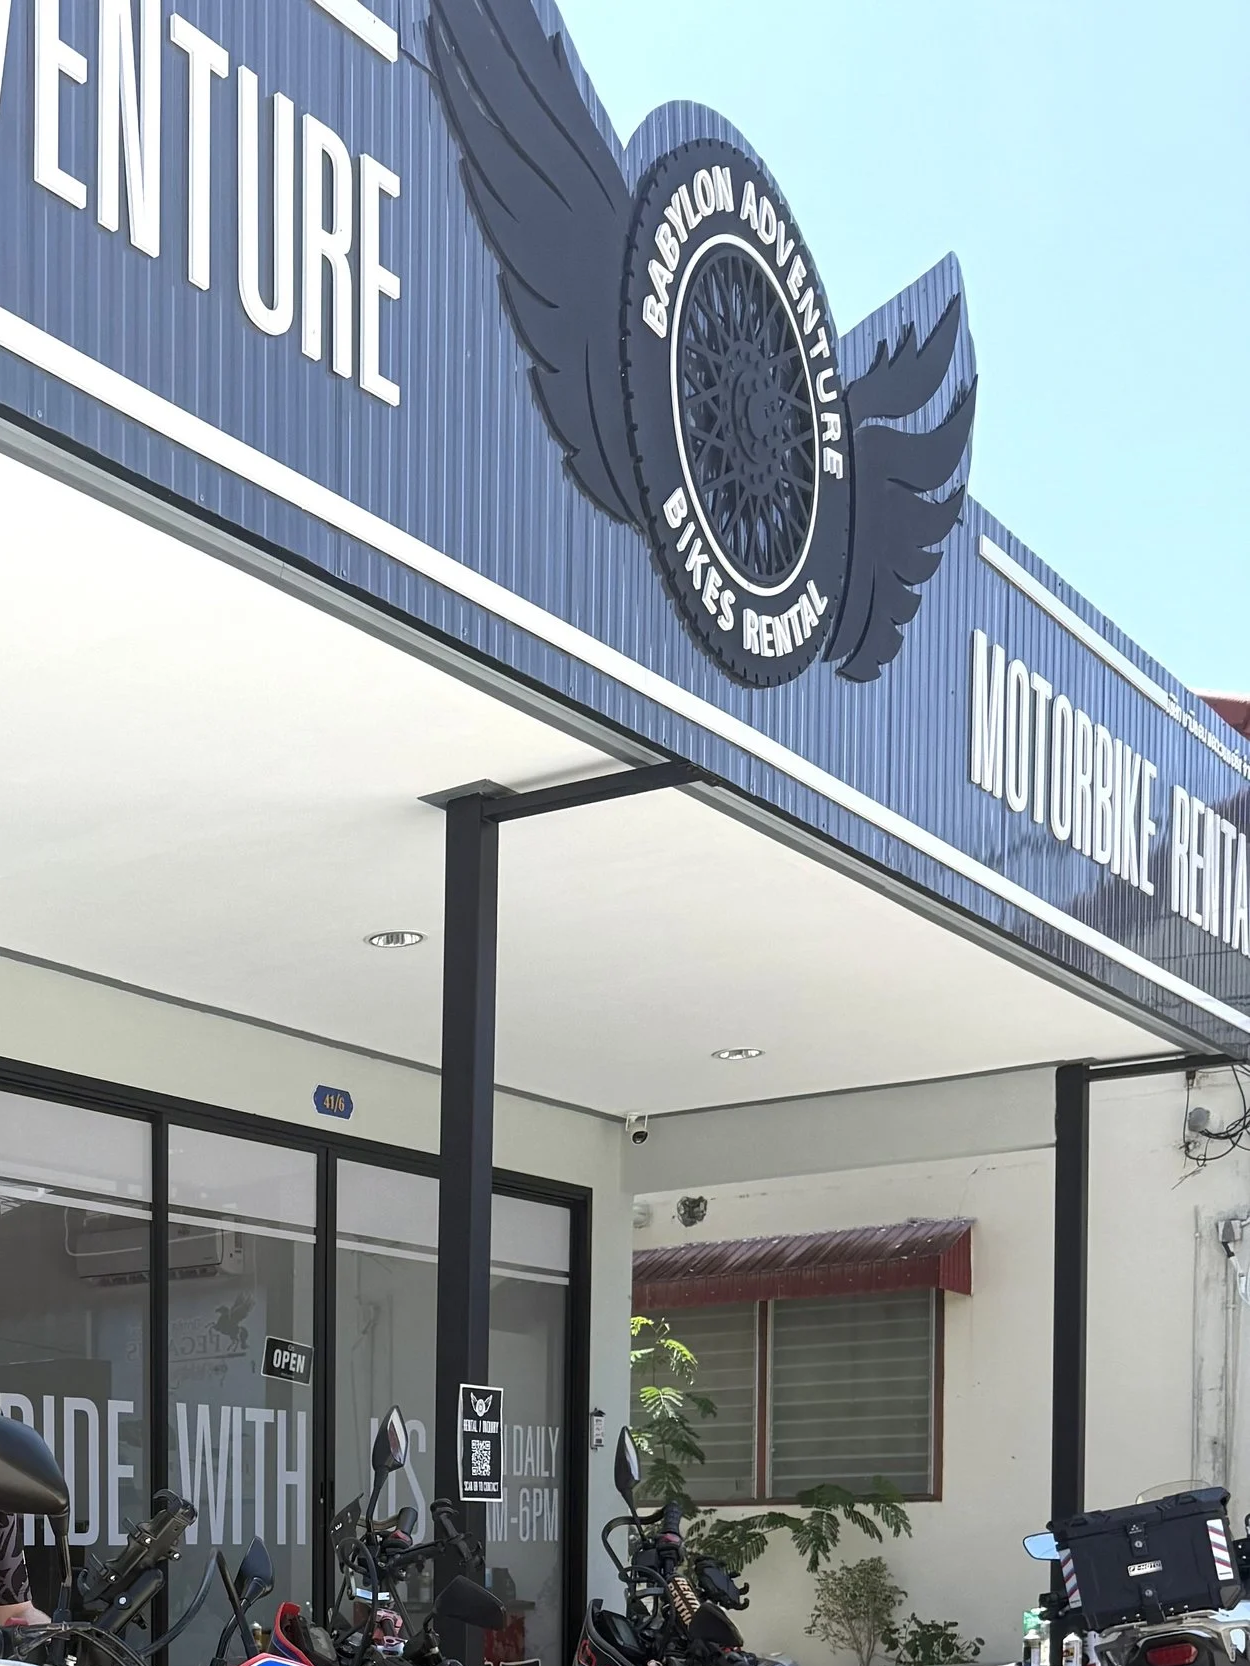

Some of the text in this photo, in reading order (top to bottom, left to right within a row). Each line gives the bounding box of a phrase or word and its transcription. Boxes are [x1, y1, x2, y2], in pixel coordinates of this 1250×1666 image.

[642, 165, 844, 480] BABYLON ADVENTURE
[662, 486, 829, 658] BIKES RENTAL
[970, 629, 1157, 897] MOTORBIKE
[323, 1093, 345, 1113] 41/6
[272, 1348, 306, 1374] OPEN
[176, 1402, 307, 1546] WITH
